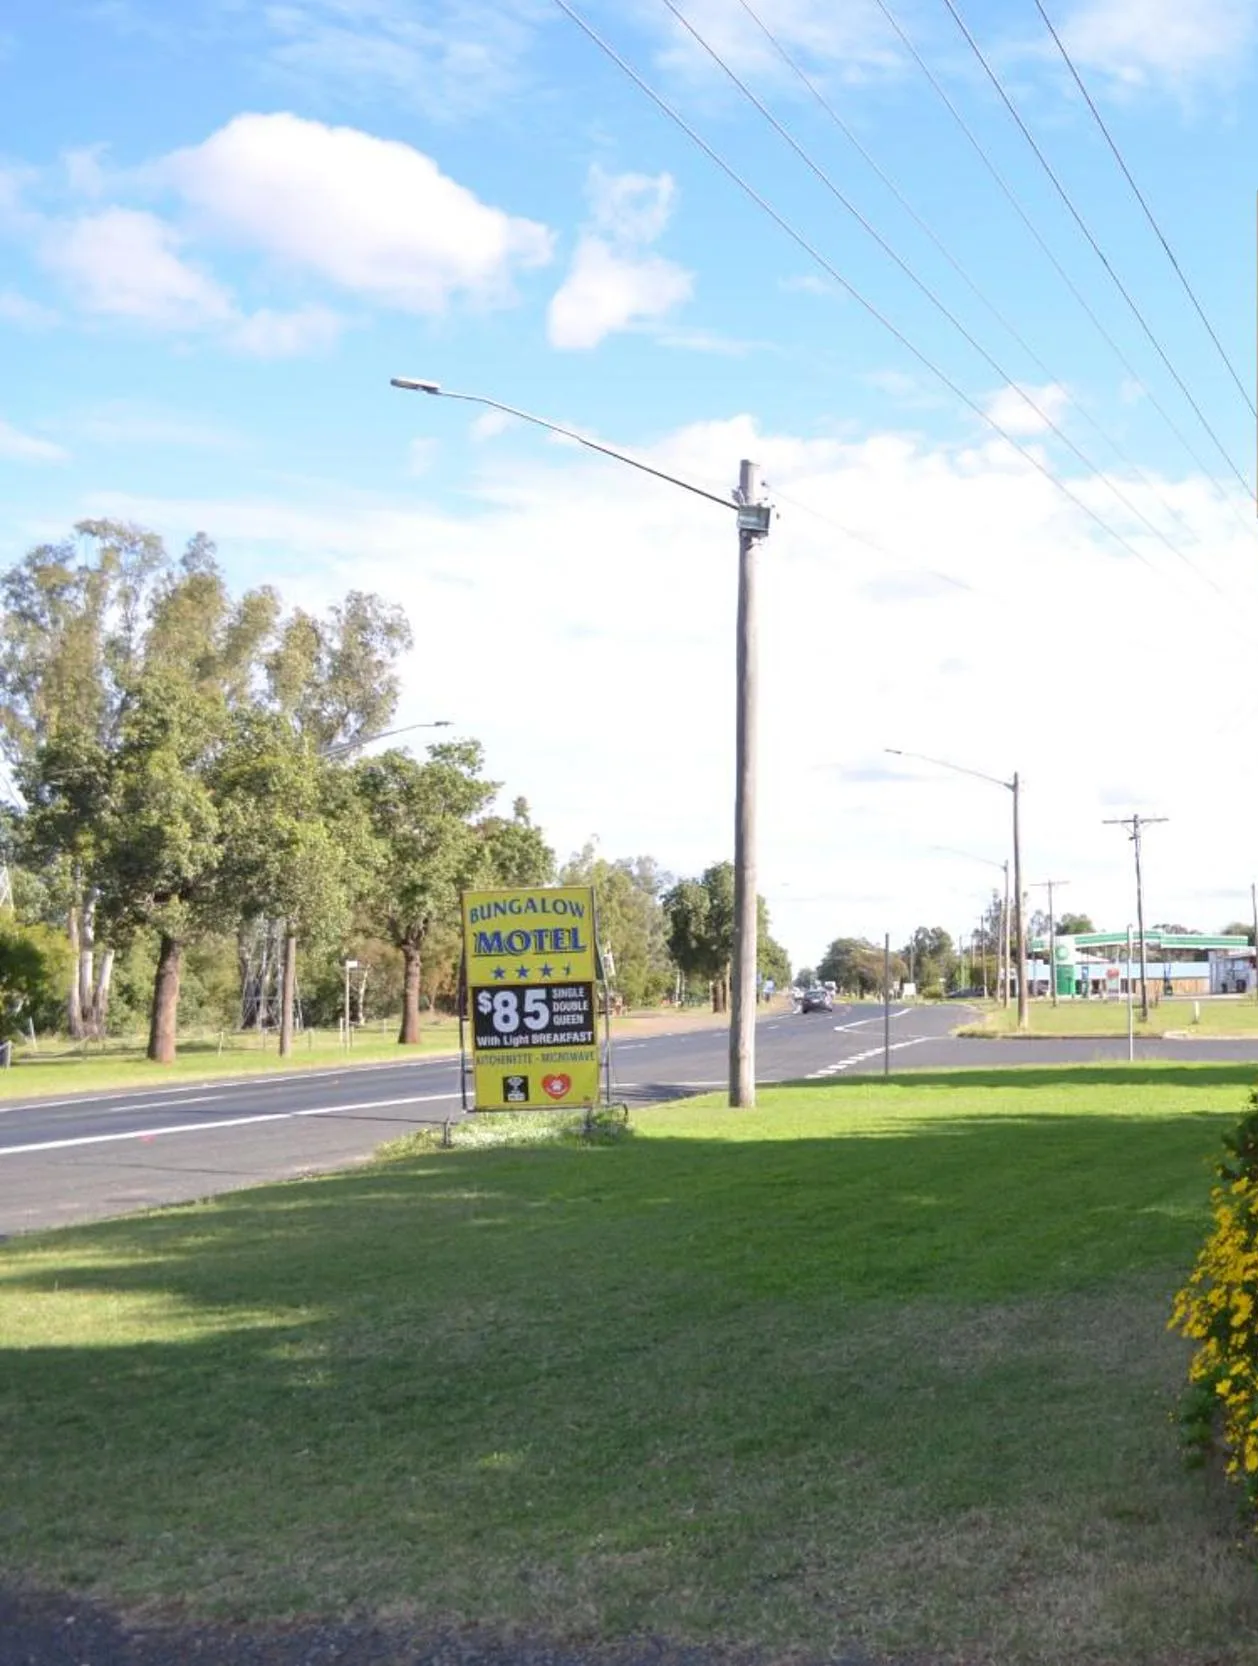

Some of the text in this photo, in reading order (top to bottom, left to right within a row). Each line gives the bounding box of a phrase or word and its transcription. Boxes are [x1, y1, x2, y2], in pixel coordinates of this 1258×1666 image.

[470, 898, 585, 924] BUNGALOW
[474, 927, 587, 955] MOTEL
[552, 987, 585, 999] SINGLE
[477, 988, 550, 1033] $85
[553, 1000, 589, 1012] DOUBLE
[553, 1014, 585, 1026] QUEEN
[477, 1031, 593, 1048] With Light BREAKFAST
